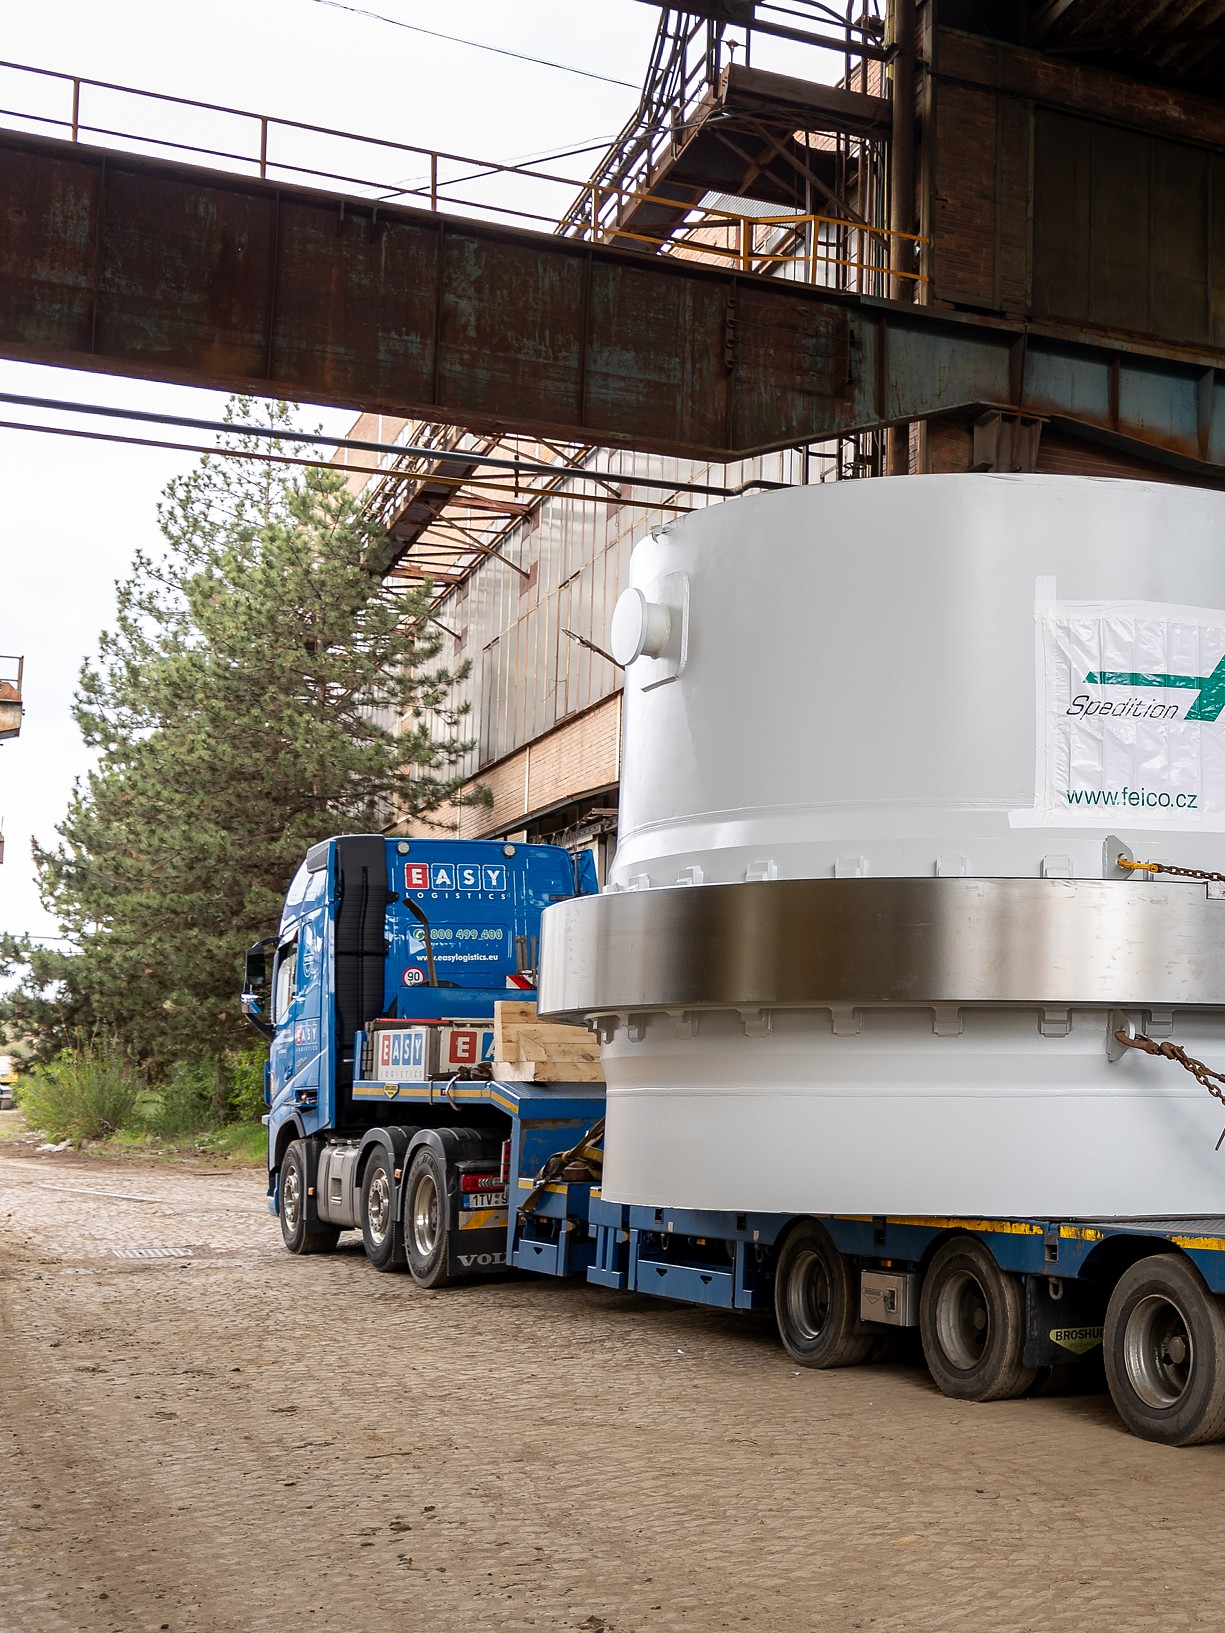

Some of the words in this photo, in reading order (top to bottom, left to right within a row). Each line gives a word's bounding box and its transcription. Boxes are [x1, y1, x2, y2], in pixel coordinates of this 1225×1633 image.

[1066, 695, 1179, 721] Spedition
[1066, 787, 1198, 809] www.feico.cz
[409, 867, 502, 888] EASY
[405, 892, 506, 900] LOGISTICS
[430, 928, 453, 940] 800
[456, 928, 478, 940] 499
[481, 928, 503, 940] 400
[416, 953, 498, 963] ww.easylogistics.eu
[407, 971, 420, 981] 90
[296, 1026, 317, 1043] EASY
[382, 1037, 422, 1062] EASY
[381, 1070, 423, 1078] LOGISTICS
[473, 1193, 493, 1207] 1TV
[457, 1252, 507, 1267] VOL
[1055, 1327, 1103, 1341] BROSHUI
